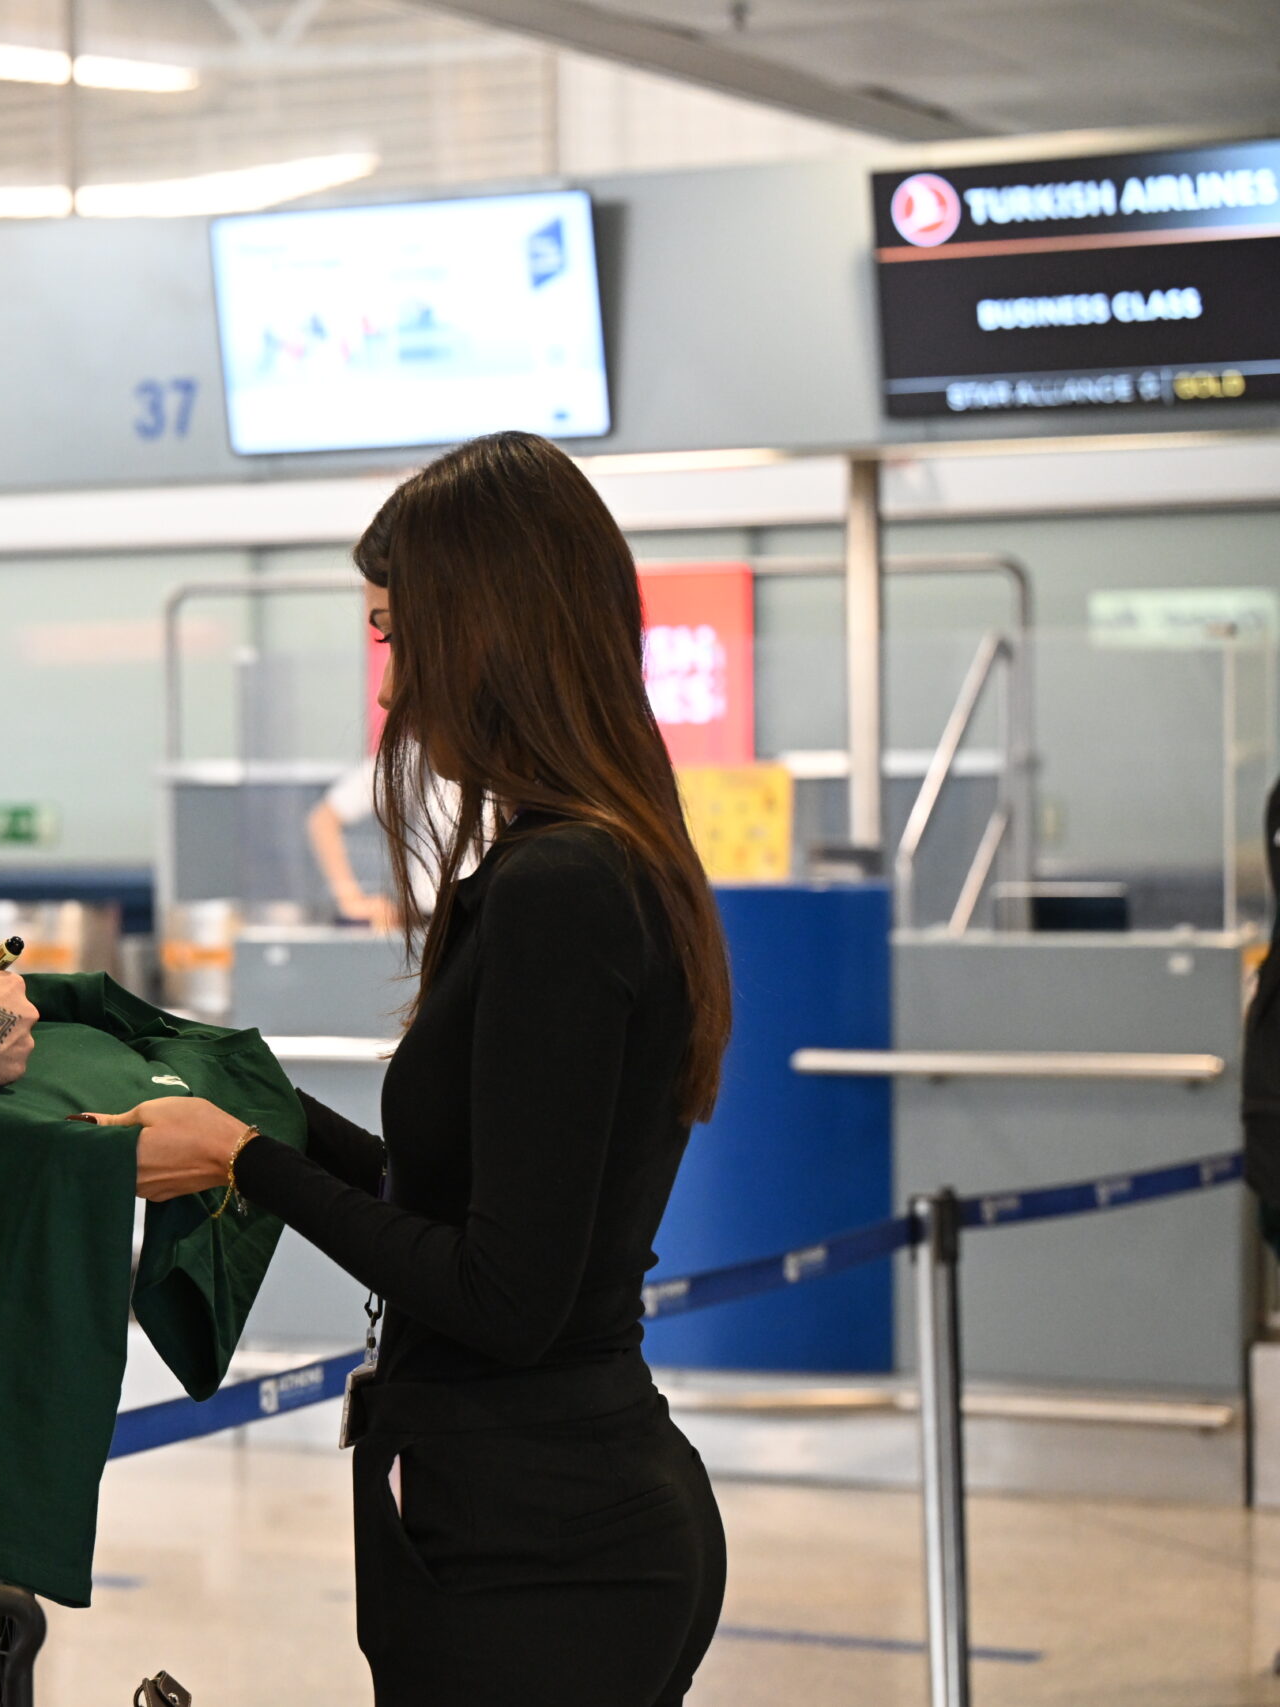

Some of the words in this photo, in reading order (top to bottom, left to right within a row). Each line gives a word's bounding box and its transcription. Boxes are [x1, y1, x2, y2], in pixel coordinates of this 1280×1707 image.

[964, 179, 1117, 225] TURKISH
[1120, 168, 1278, 215] AIRLINES
[977, 293, 1111, 331] BUSINESS
[1112, 287, 1202, 323] CLASS
[133, 378, 198, 441] 37
[1173, 369, 1246, 400] GOLD
